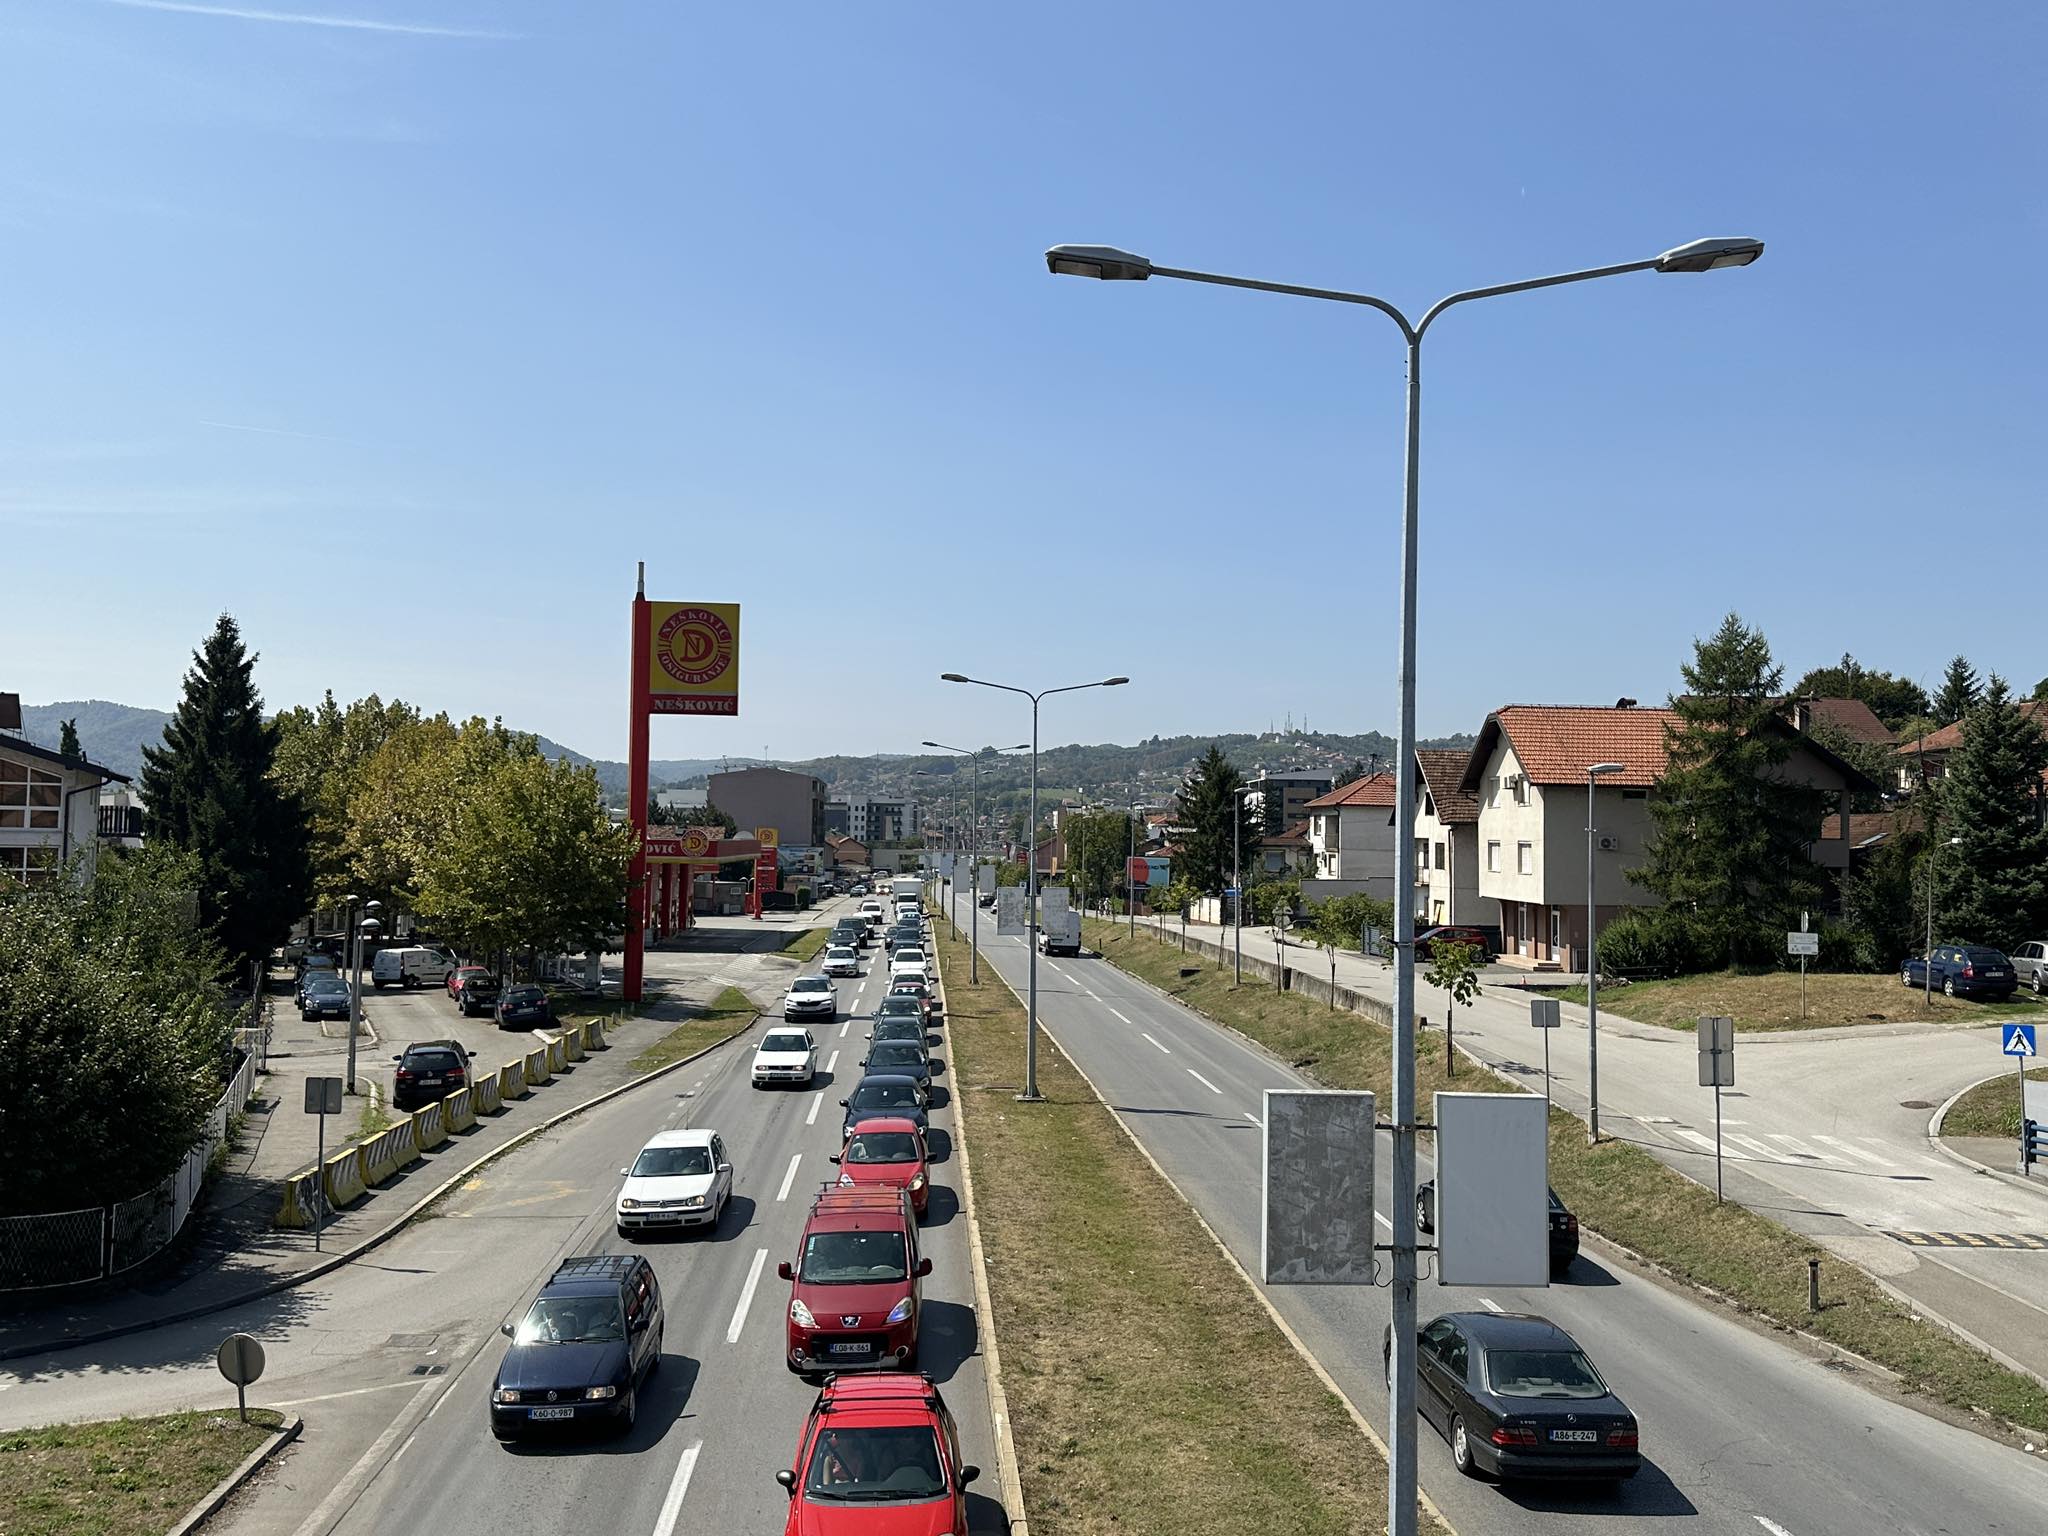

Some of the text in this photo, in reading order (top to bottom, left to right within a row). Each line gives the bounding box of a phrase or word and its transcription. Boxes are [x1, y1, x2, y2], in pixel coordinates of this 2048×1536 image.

[661, 655, 727, 683] OSIGURANJE
[654, 698, 733, 712] NEŠKOVIĆ
[1554, 1431, 1595, 1440] A86-E-247
